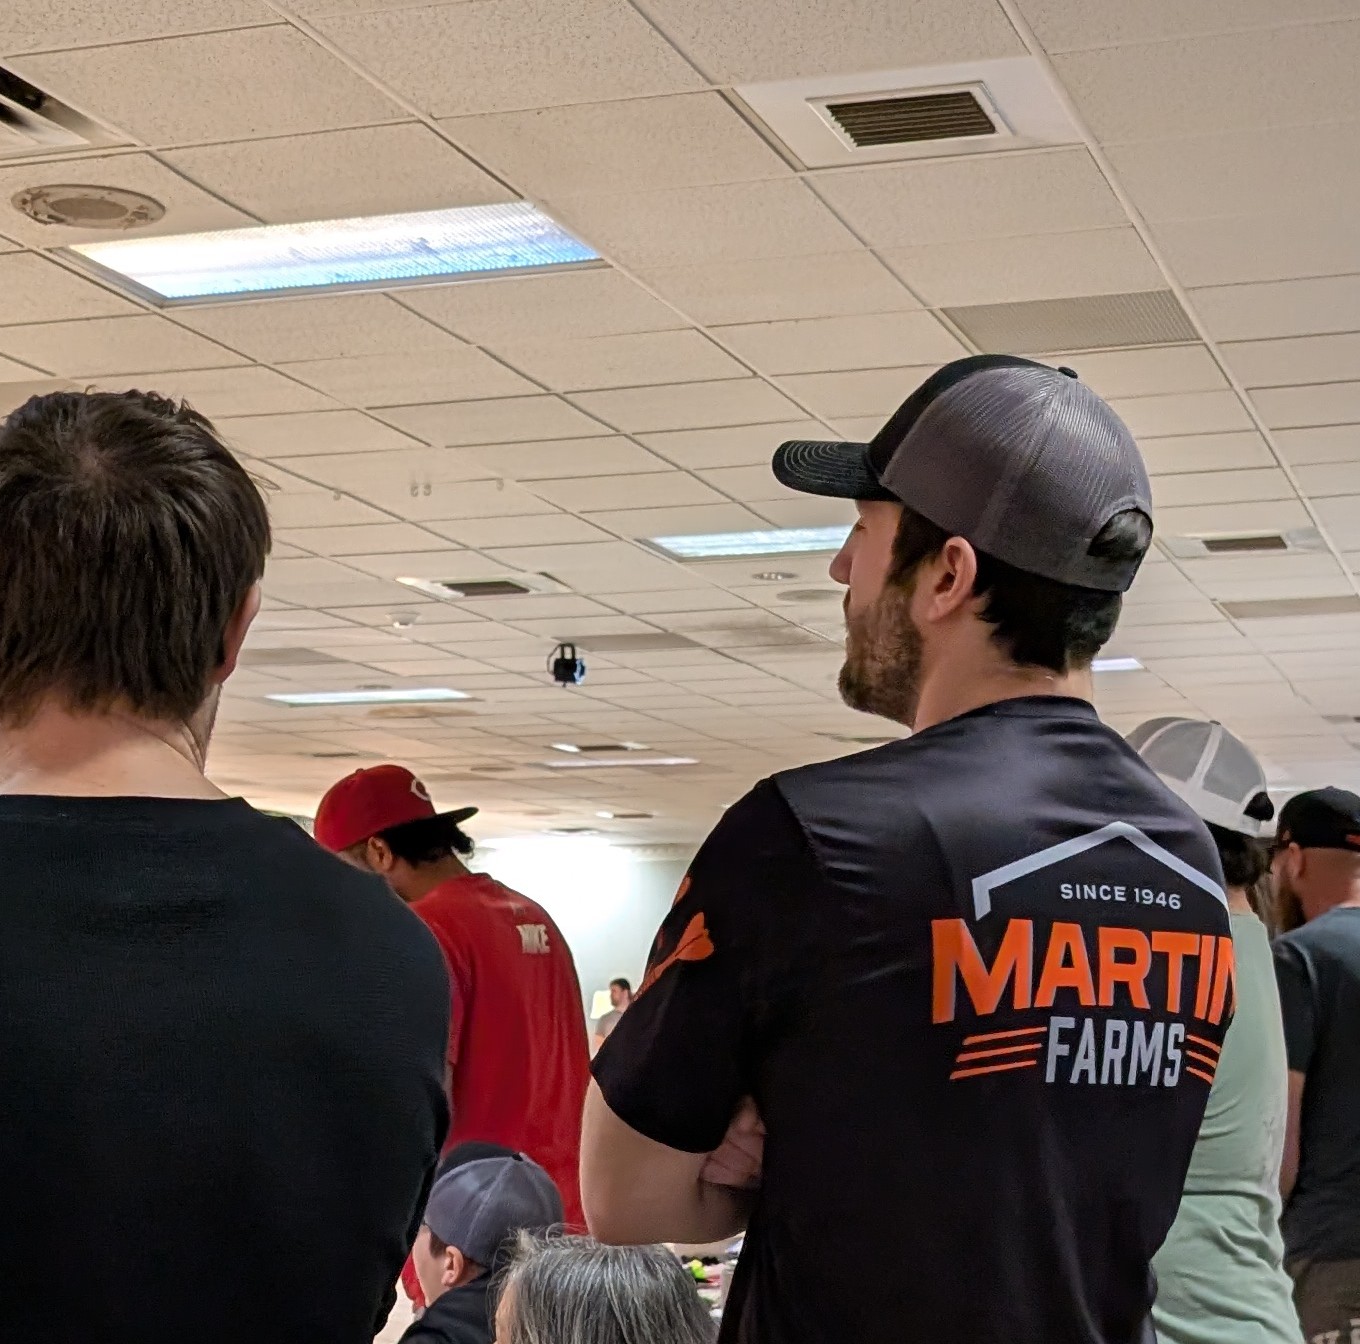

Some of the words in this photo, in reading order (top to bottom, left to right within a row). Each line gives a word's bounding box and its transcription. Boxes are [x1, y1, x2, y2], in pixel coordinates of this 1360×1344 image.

[1060, 883, 1126, 902] SINCE
[1133, 887, 1182, 910] 1946
[1045, 1015, 1187, 1088] FARMS
